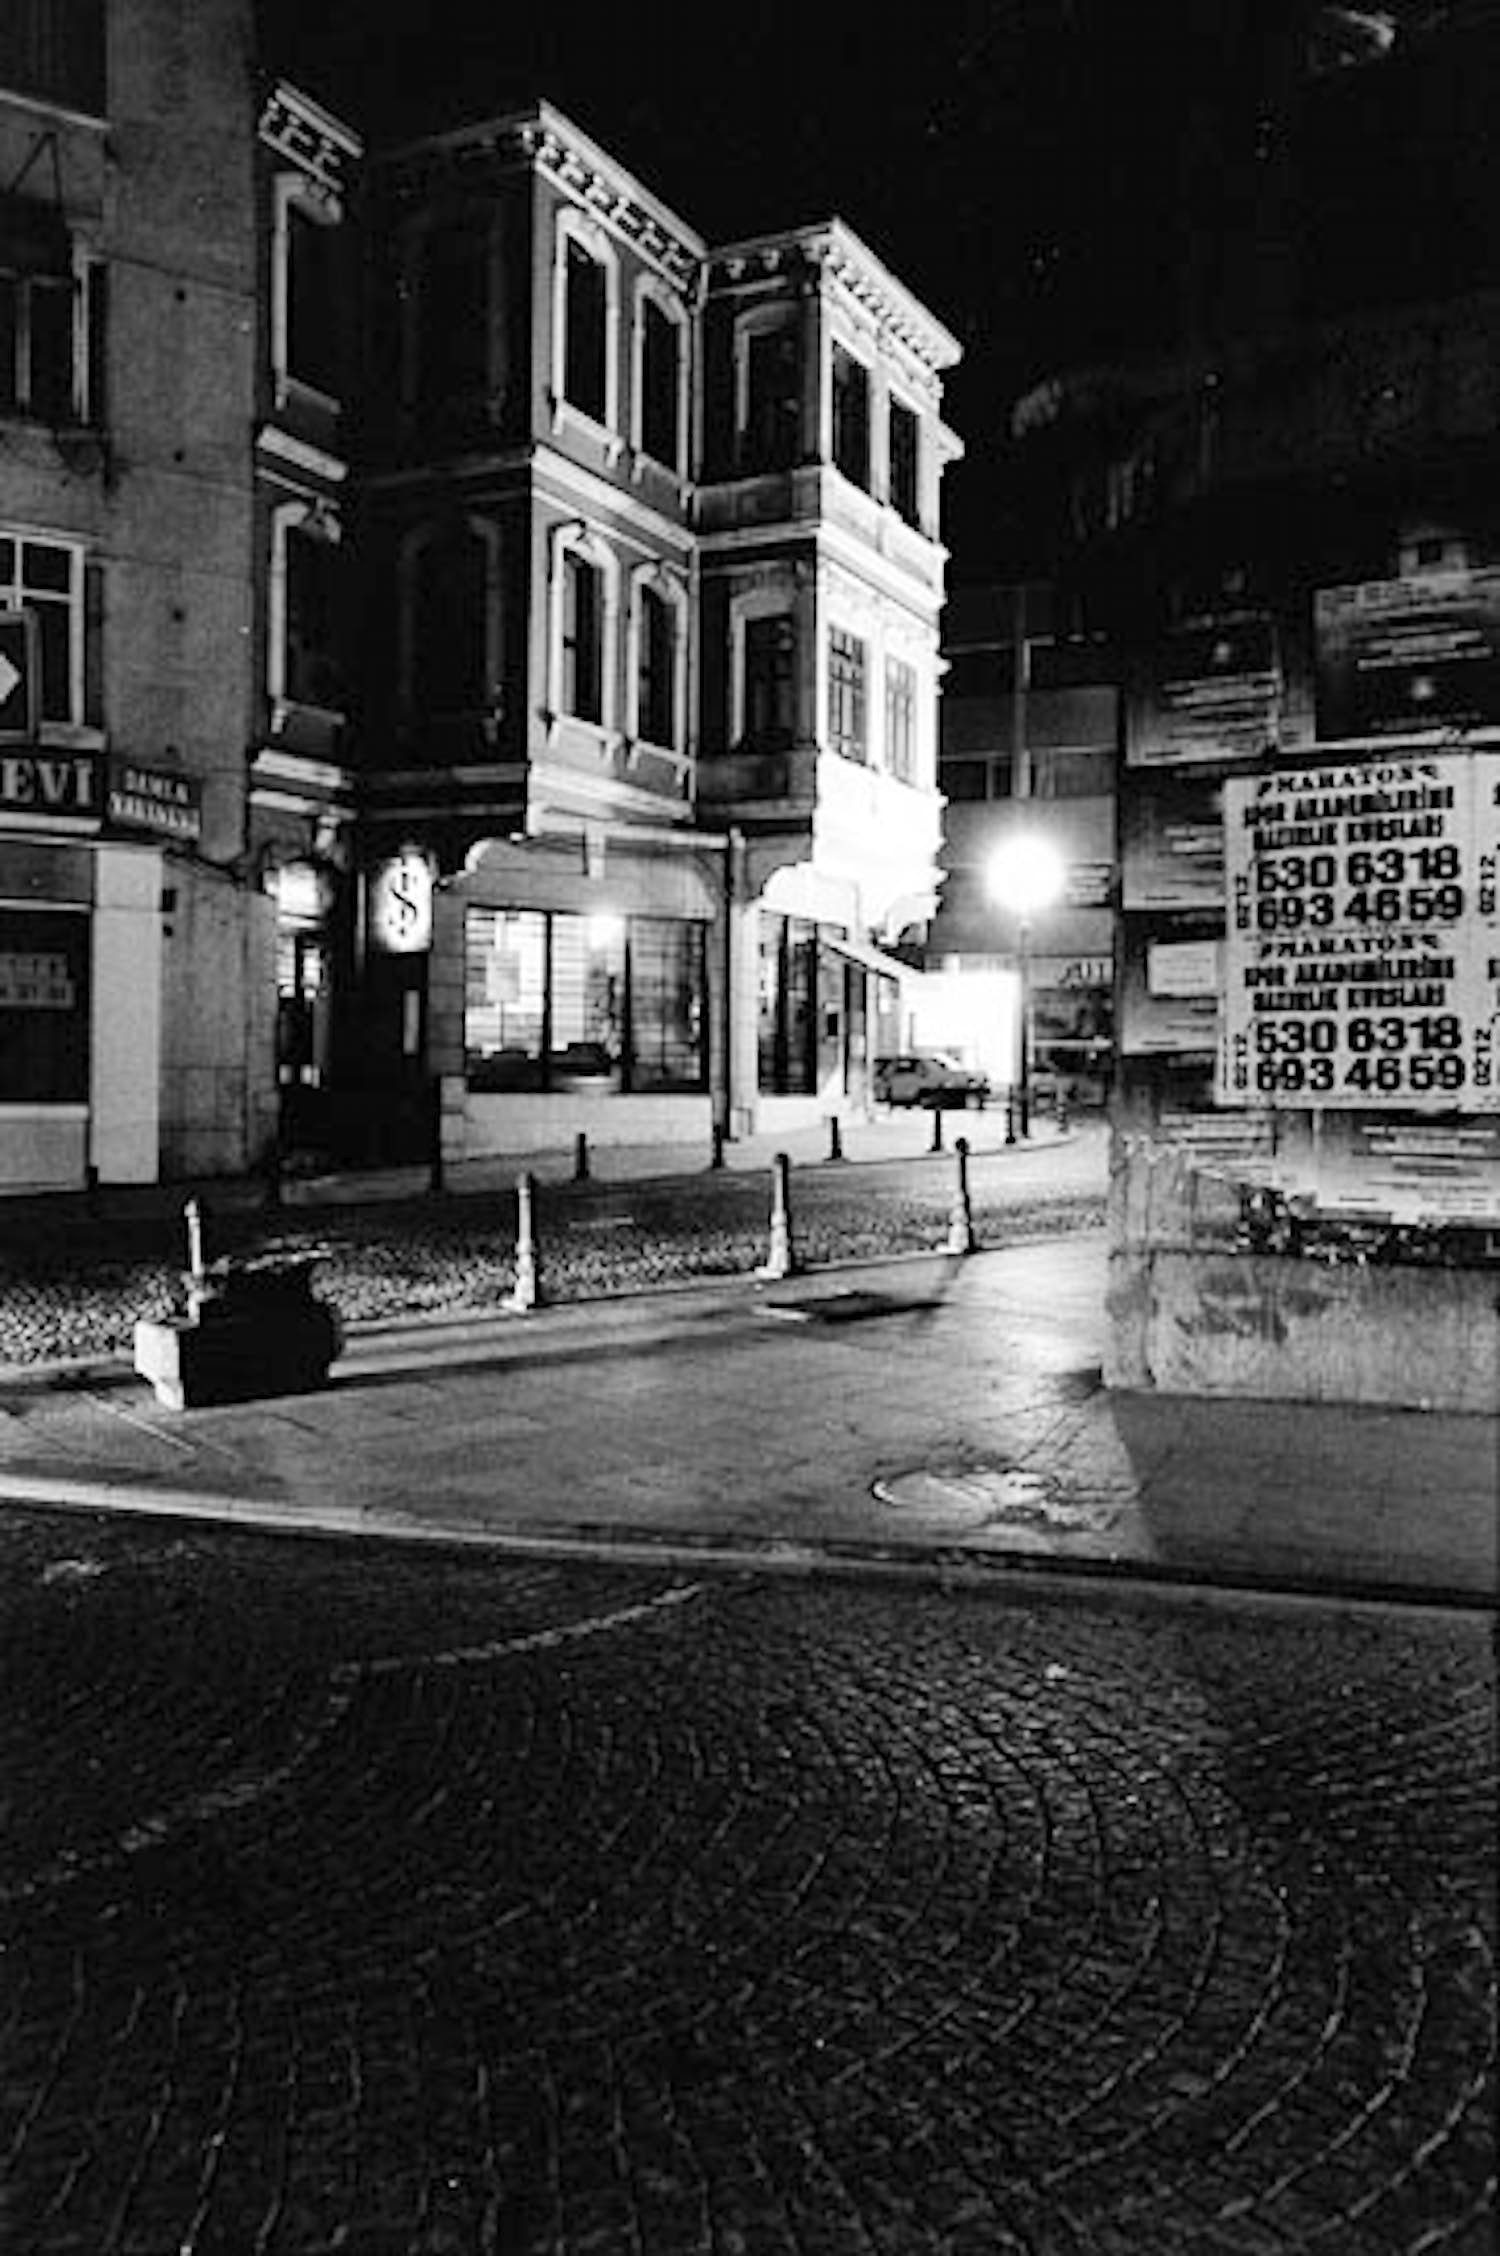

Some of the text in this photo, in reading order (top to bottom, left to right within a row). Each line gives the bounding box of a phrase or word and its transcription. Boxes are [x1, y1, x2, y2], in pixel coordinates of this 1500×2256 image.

[1257, 856, 1336, 892] 530
[1257, 893, 1334, 929] 693
[1257, 1019, 1337, 1053] 530
[1257, 1057, 1334, 1091] 693
